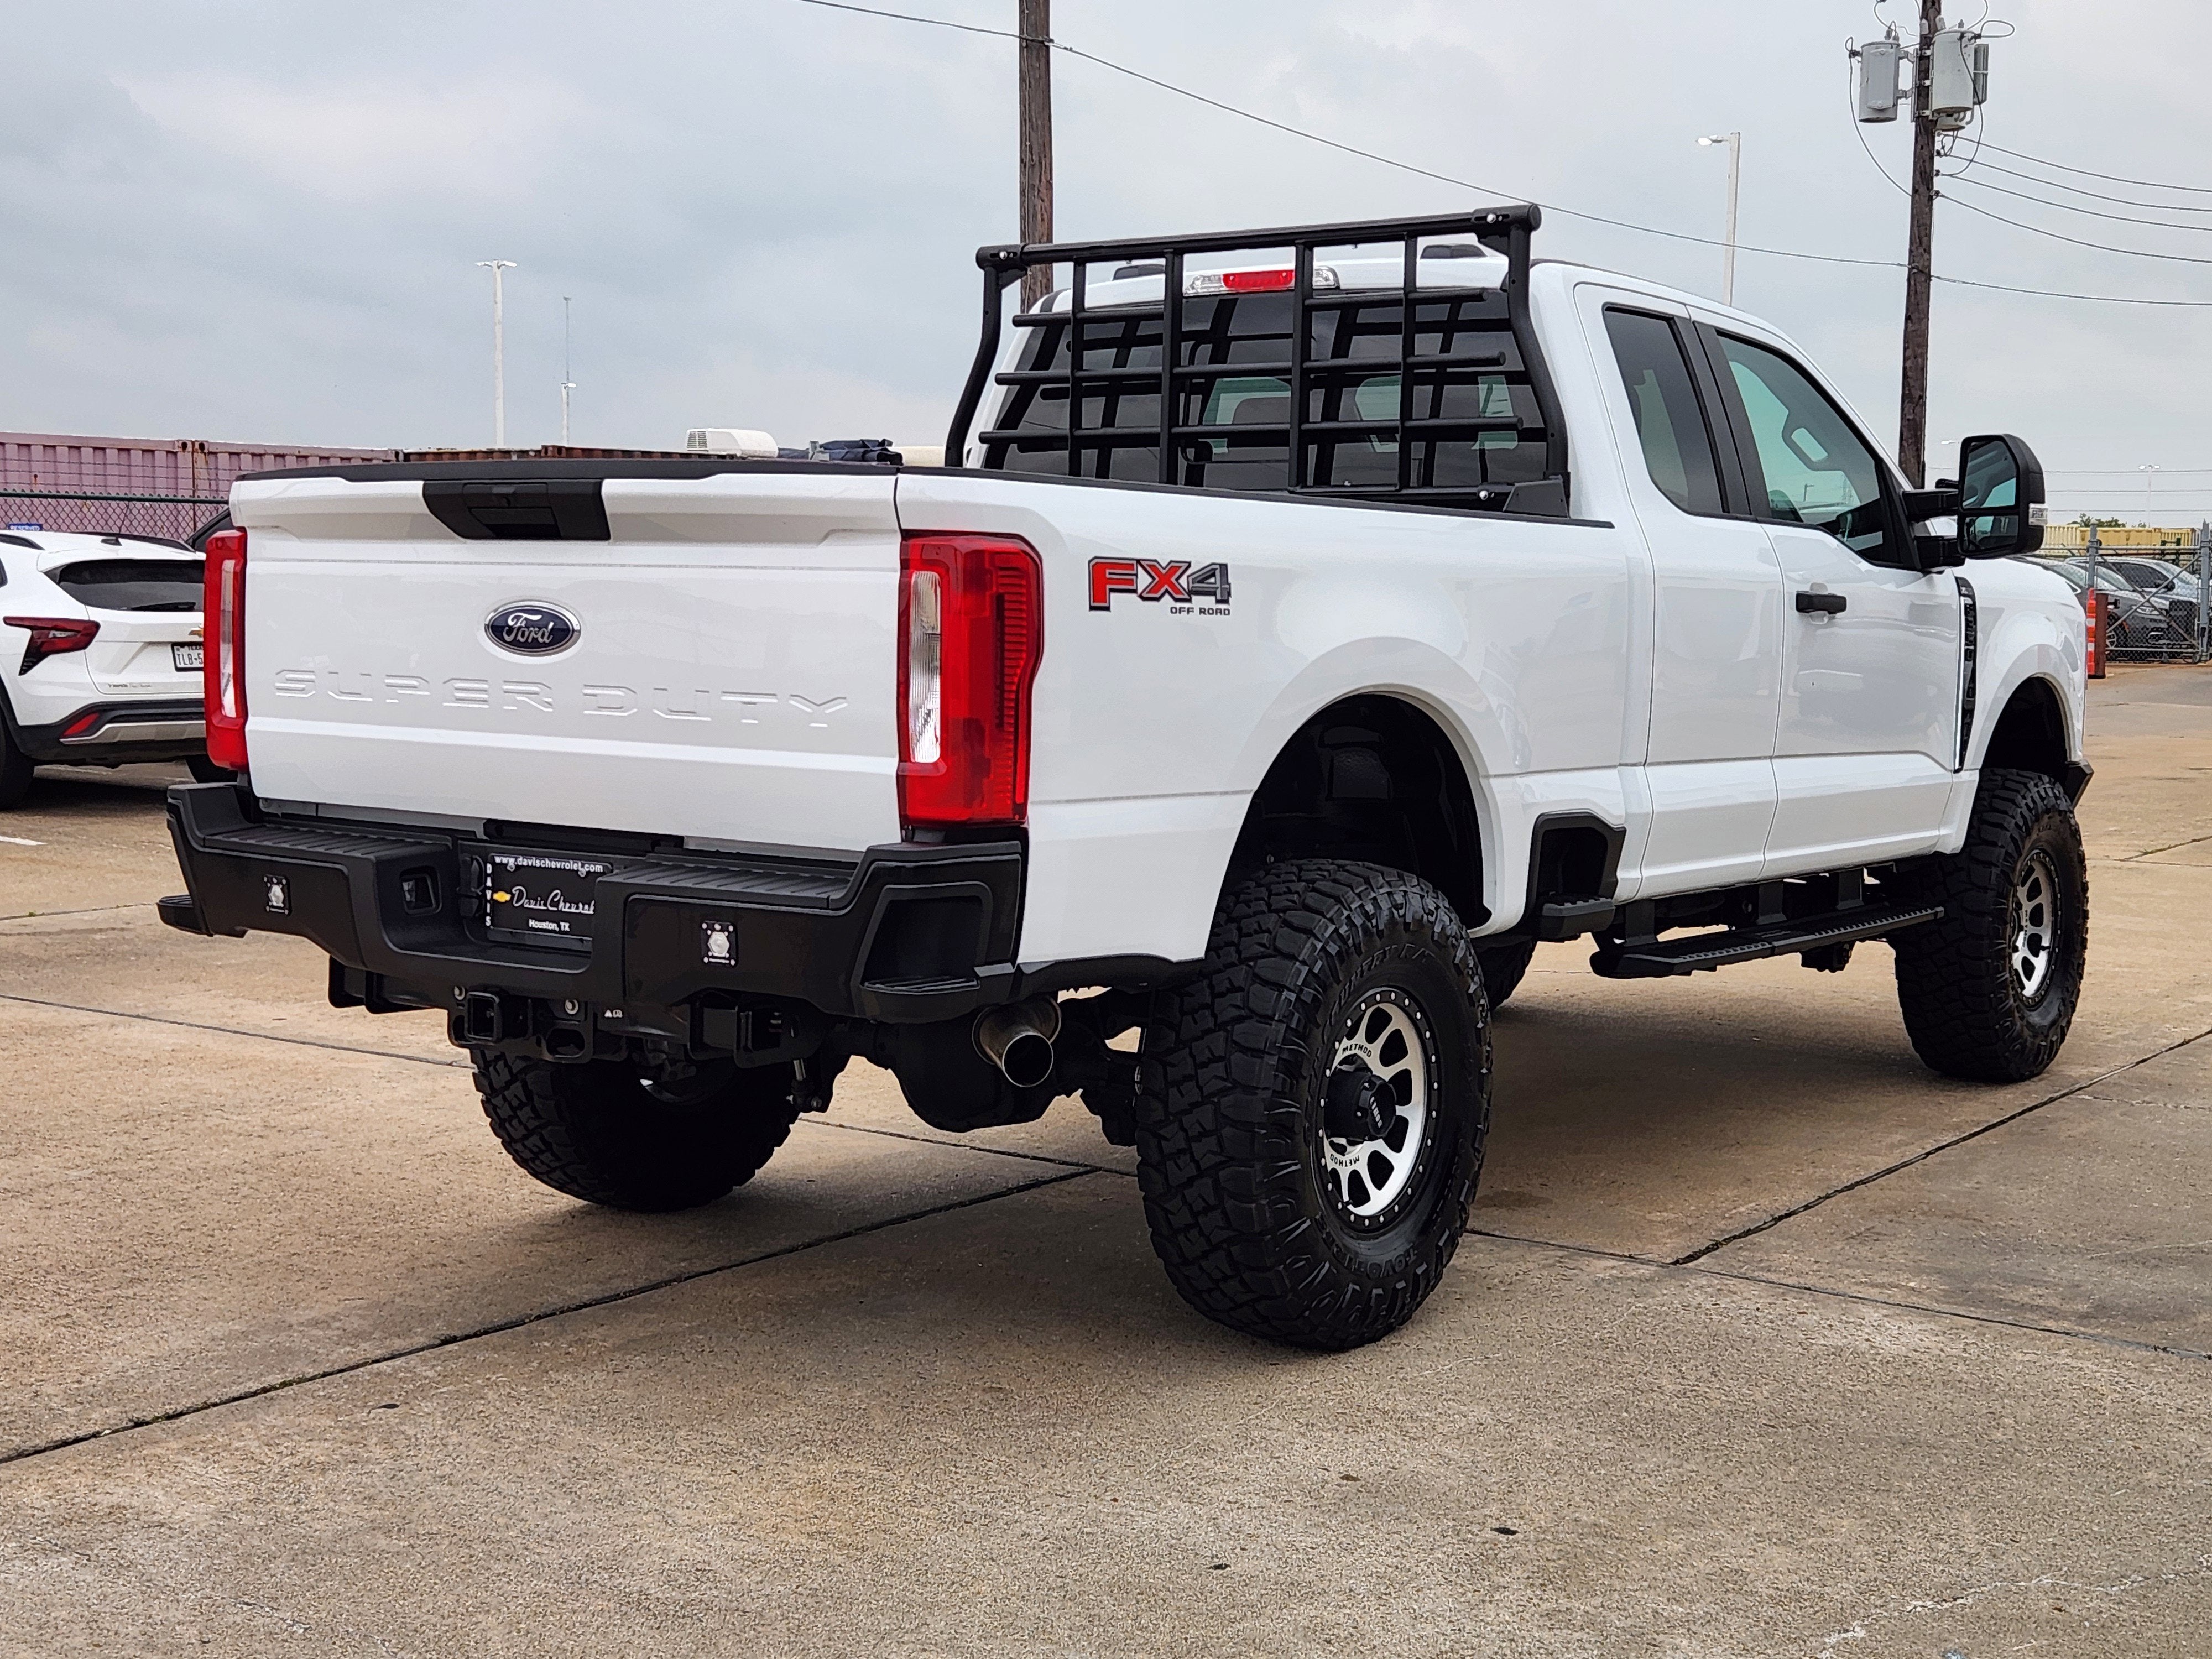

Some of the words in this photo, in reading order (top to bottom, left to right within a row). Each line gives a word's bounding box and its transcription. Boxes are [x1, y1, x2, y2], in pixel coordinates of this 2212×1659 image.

[1088, 556, 1232, 612] FX4
[1170, 606, 1194, 615] OFF
[1199, 607, 1230, 616] ROAD
[503, 612, 554, 643] Ford
[274, 669, 553, 712] SUPER
[582, 684, 848, 727] DUTY
[494, 856, 603, 873] www.davischevrolet.com
[529, 919, 559, 932] Houston,
[560, 922, 570, 931] TX
[1342, 1044, 1372, 1057] METHOD
[1330, 1154, 1359, 1167] METHOD
